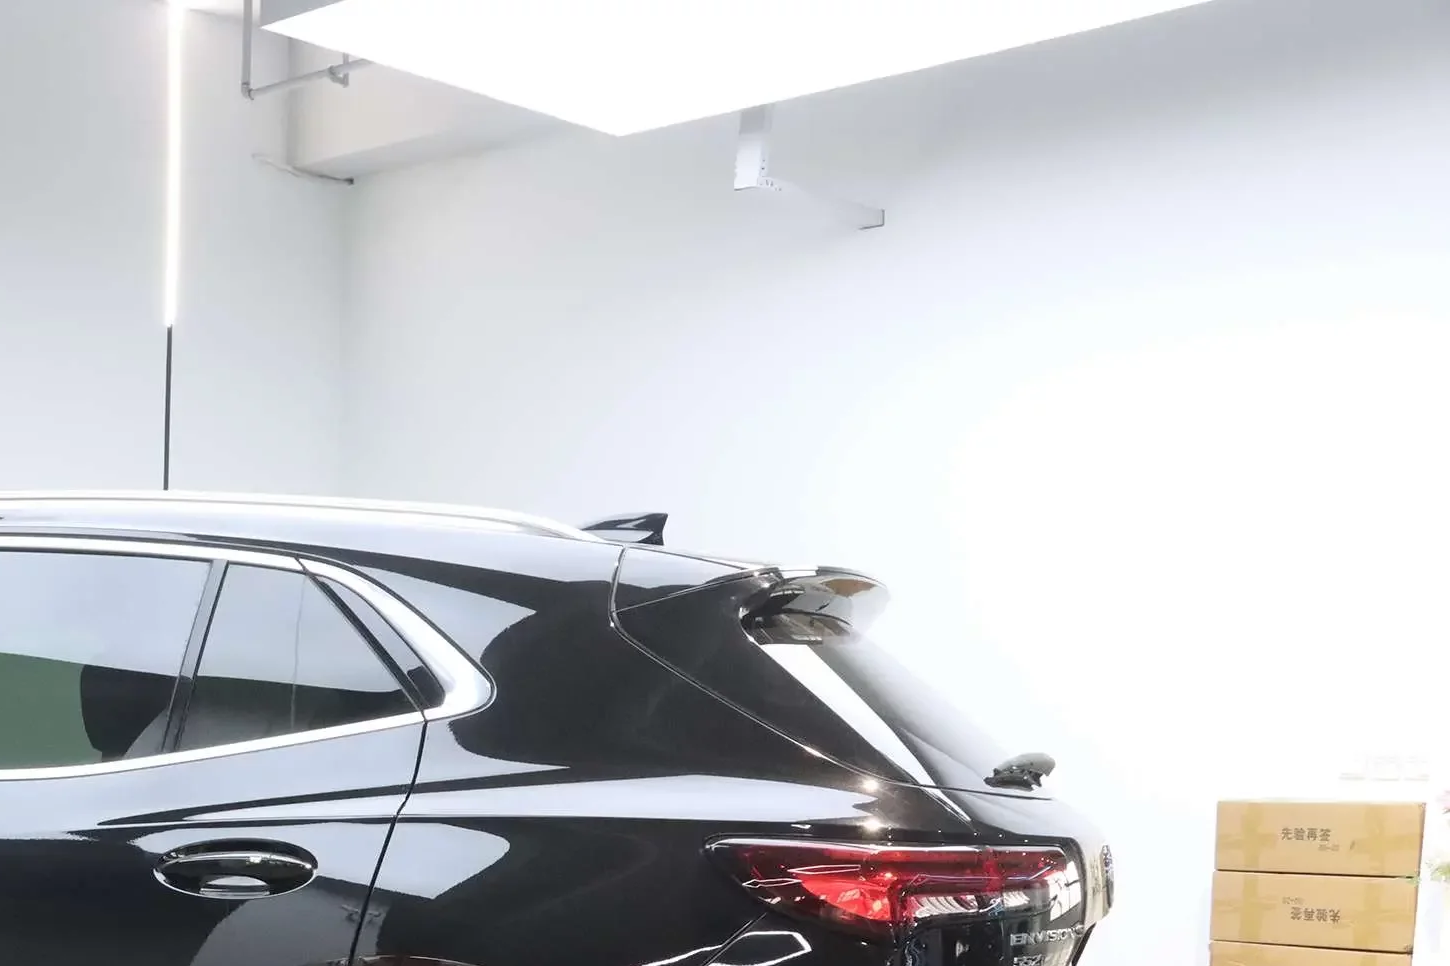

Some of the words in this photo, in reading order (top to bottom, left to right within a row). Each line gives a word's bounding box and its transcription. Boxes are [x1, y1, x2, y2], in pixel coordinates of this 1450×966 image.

[1281, 827, 1331, 842] 先验再签
[1290, 906, 1341, 925] 先验再签
